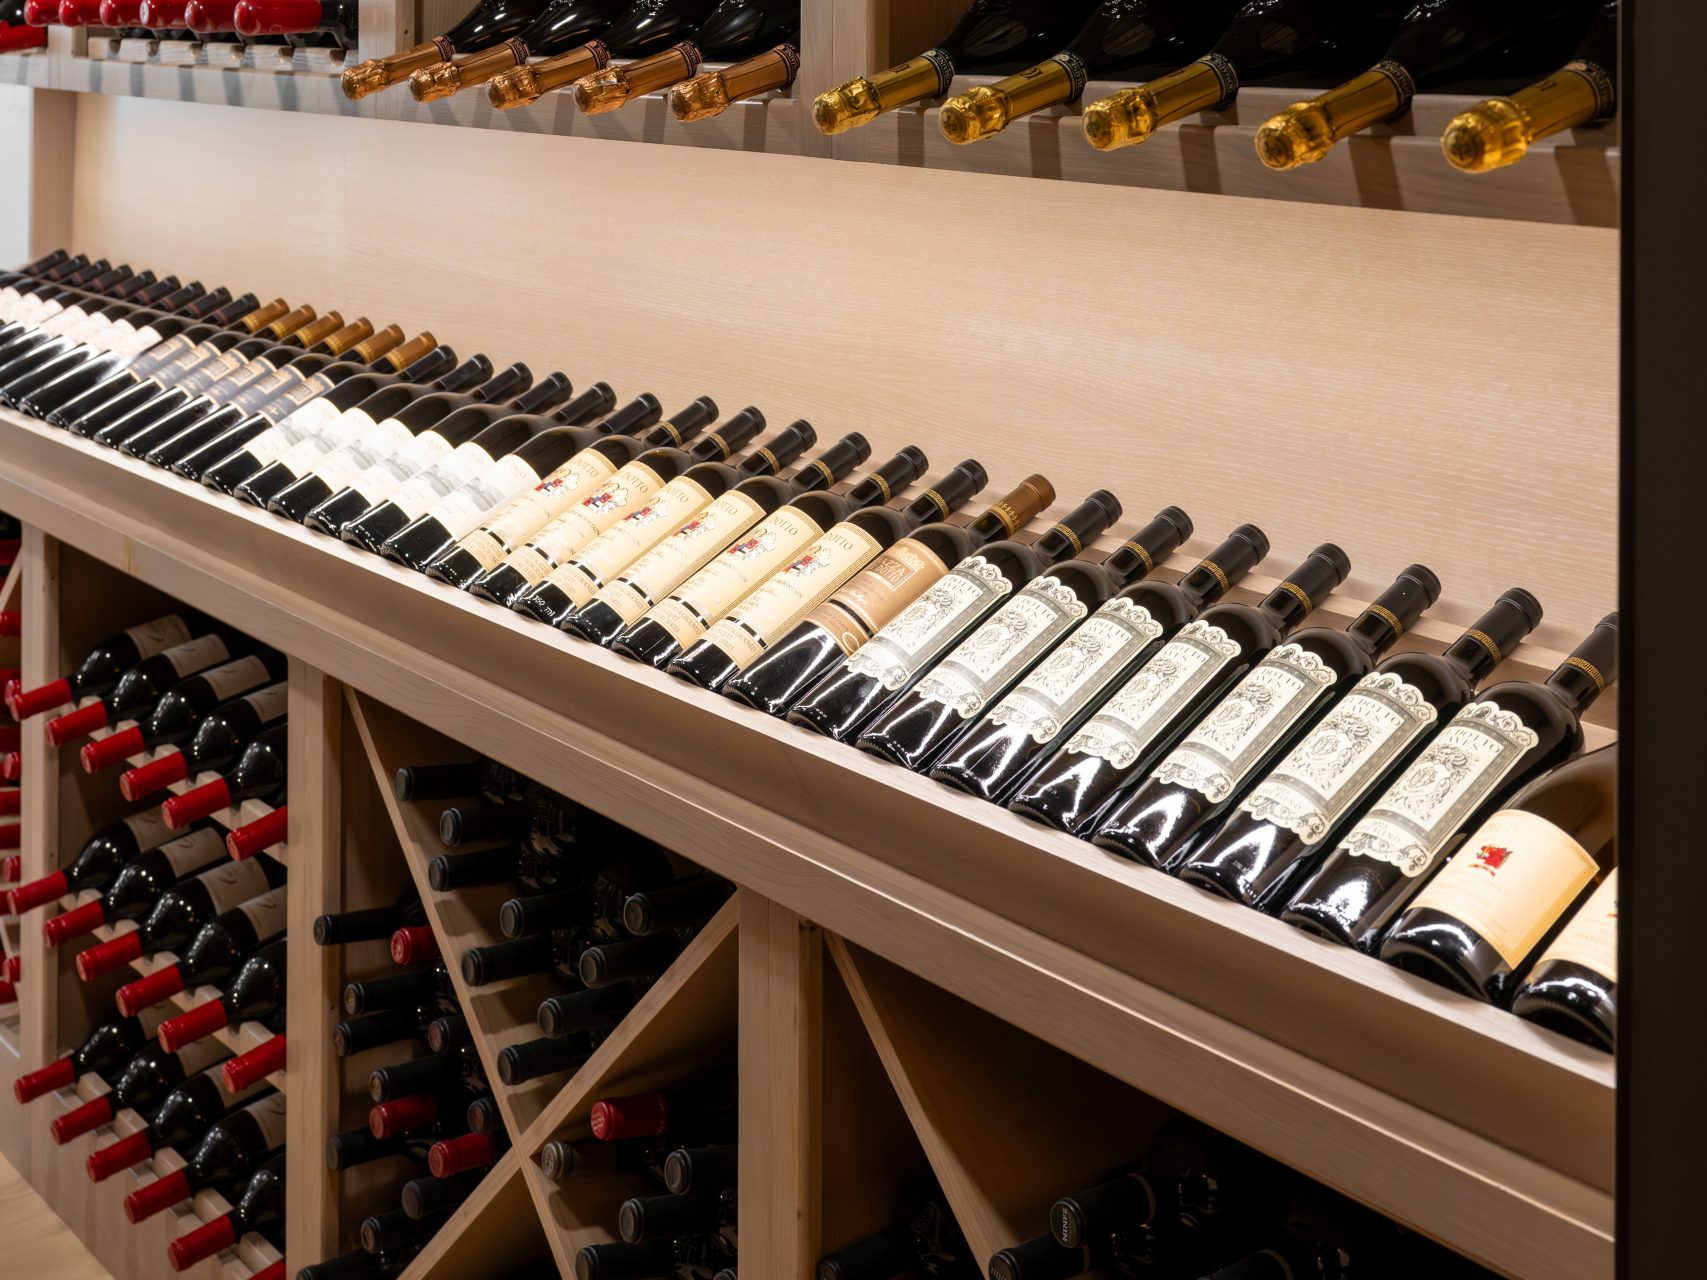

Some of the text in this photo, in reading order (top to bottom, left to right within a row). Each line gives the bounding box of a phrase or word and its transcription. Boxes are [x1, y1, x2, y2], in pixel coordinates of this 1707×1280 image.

[621, 471, 649, 494] DOTTO
[874, 563, 900, 583] DOTTO
[881, 557, 905, 577] AZZA
[533, 594, 546, 607] 750
[1358, 698, 1402, 727] DOTTO
[1455, 729, 1500, 753] DOTTO
